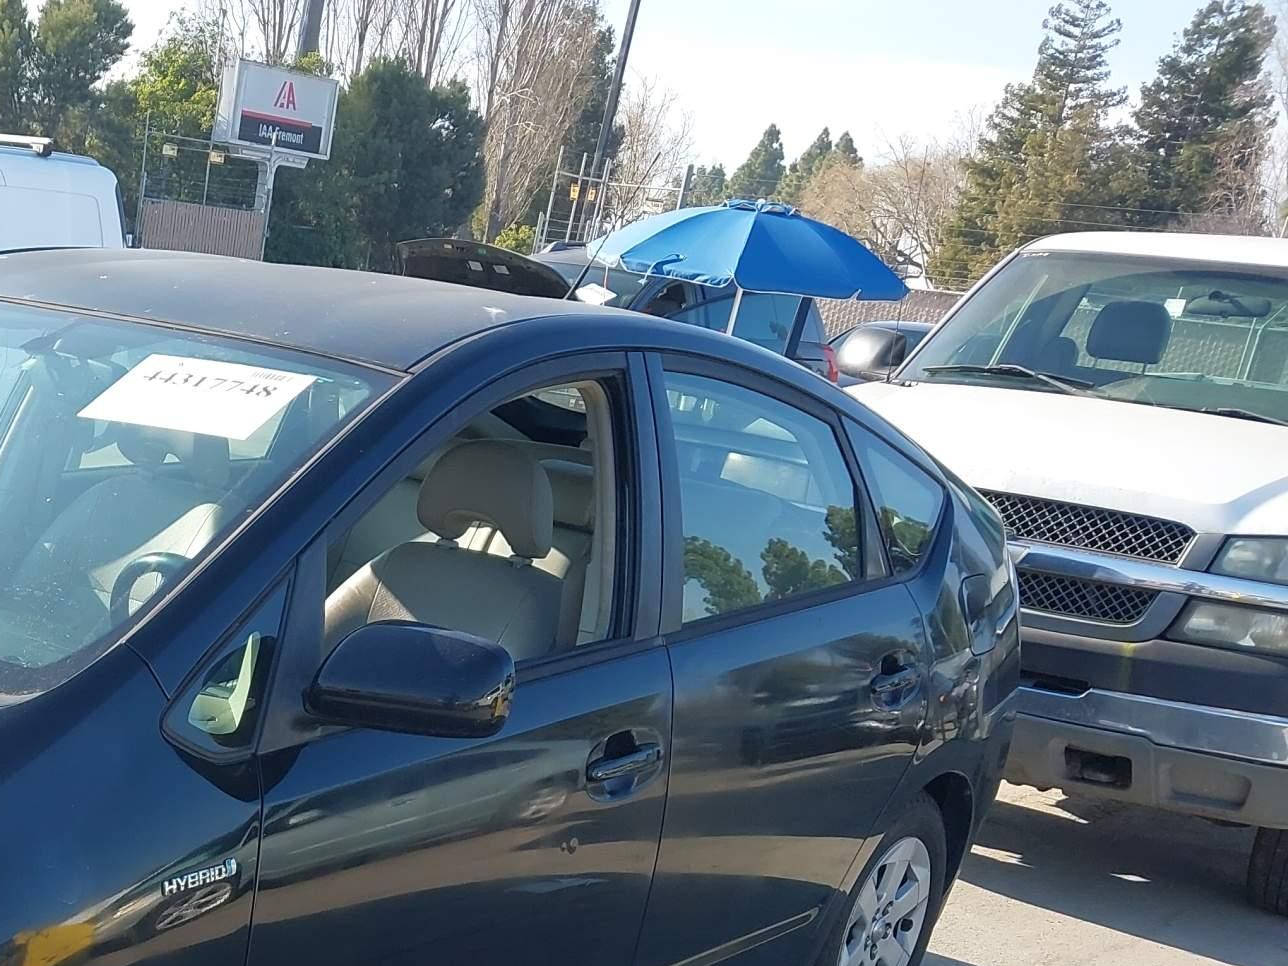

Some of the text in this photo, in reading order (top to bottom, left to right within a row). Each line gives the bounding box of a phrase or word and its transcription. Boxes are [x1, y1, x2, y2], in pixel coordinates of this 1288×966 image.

[258, 123, 304, 145] IAA Fremont
[143, 369, 279, 398] 44317748
[163, 864, 226, 897] HYBRID
